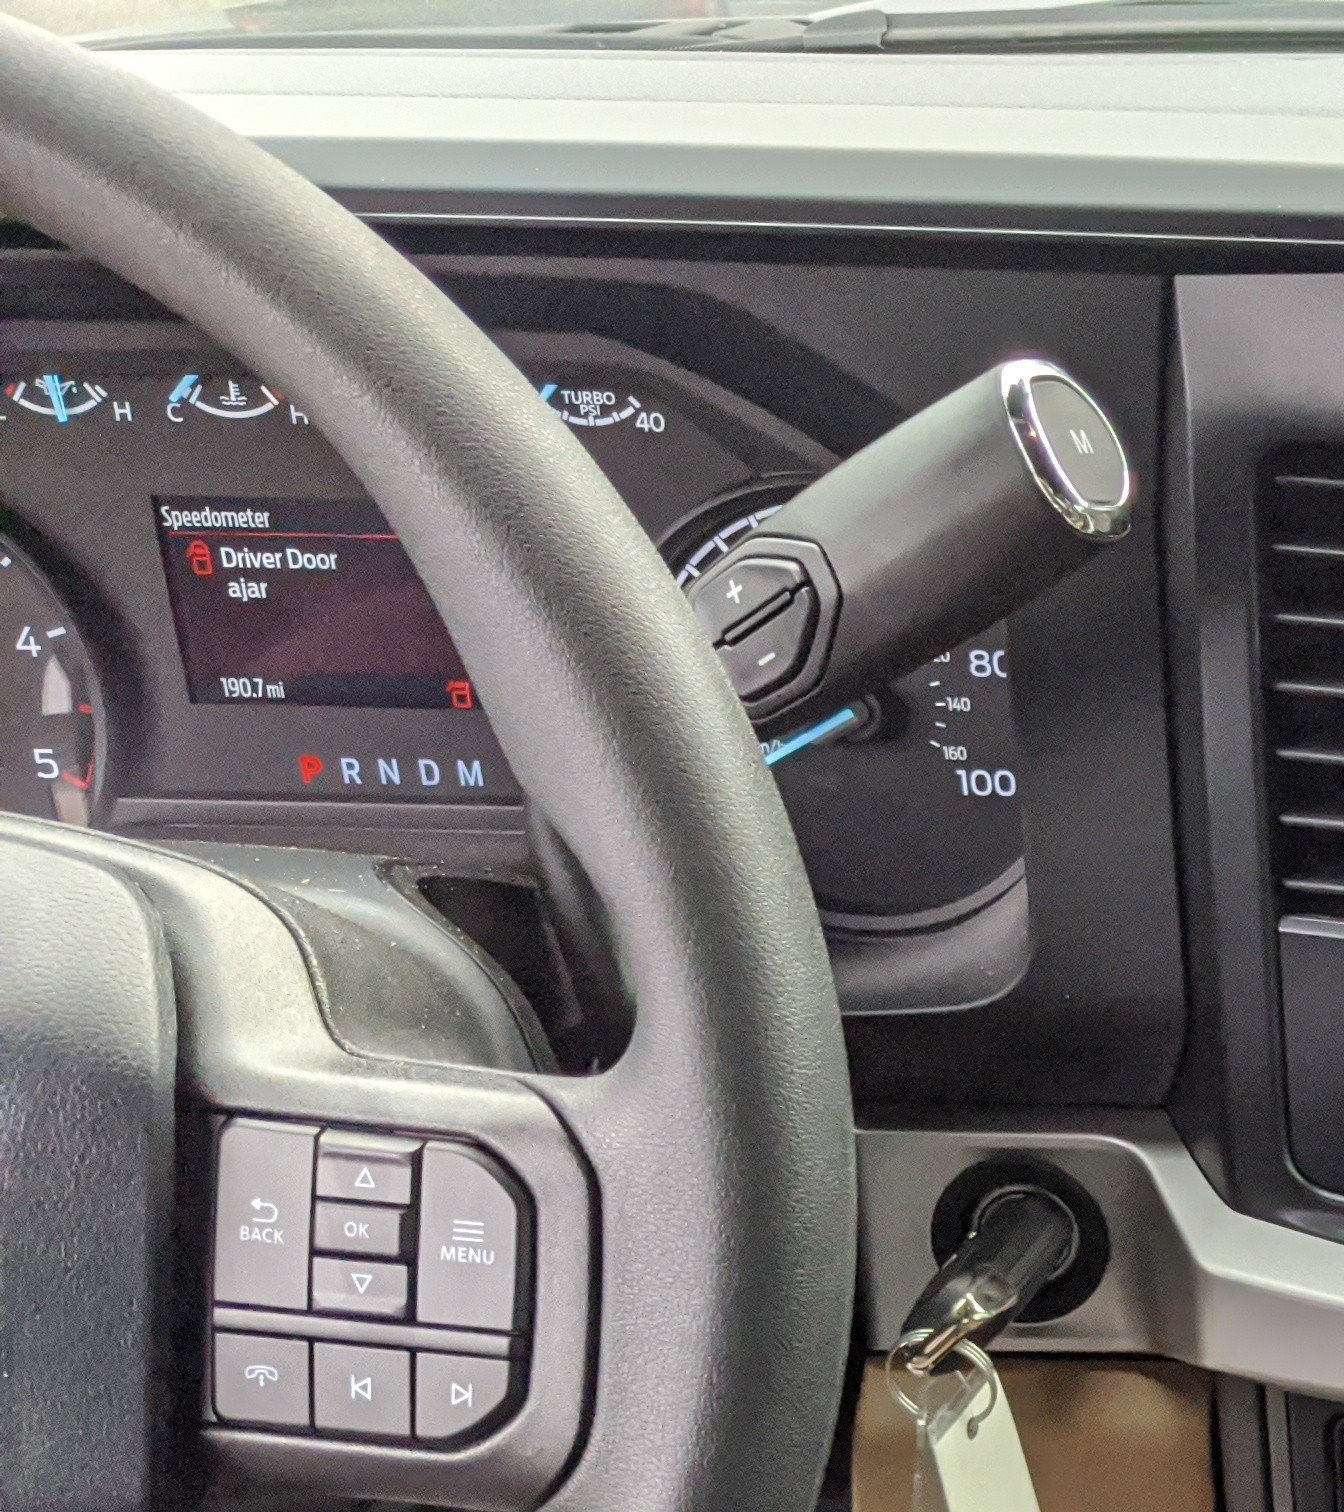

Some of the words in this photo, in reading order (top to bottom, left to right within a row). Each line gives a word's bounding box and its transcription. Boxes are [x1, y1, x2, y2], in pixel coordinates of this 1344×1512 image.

[561, 390, 616, 406] TURBO
[113, 401, 133, 421] H
[166, 403, 184, 422] C
[579, 404, 601, 416] PSI
[635, 411, 666, 433] 40
[1069, 430, 1095, 455] M
[161, 505, 271, 529] Speedometer
[220, 547, 283, 570] Driver
[286, 548, 338, 571] Door
[228, 577, 268, 602] ajar
[16, 626, 42, 658] 4
[220, 677, 264, 699] 190.7
[266, 681, 286, 699] mi
[946, 697, 971, 712] 140
[33, 748, 60, 779] 5
[943, 745, 967, 761] 160
[299, 755, 324, 784] P
[340, 757, 363, 785] R
[377, 758, 401, 785] N
[418, 758, 441, 786] D
[456, 760, 485, 787] M
[955, 769, 1017, 797] 100
[239, 1226, 284, 1245] BACK
[344, 1221, 369, 1239] OK
[440, 1246, 495, 1266] MENU
